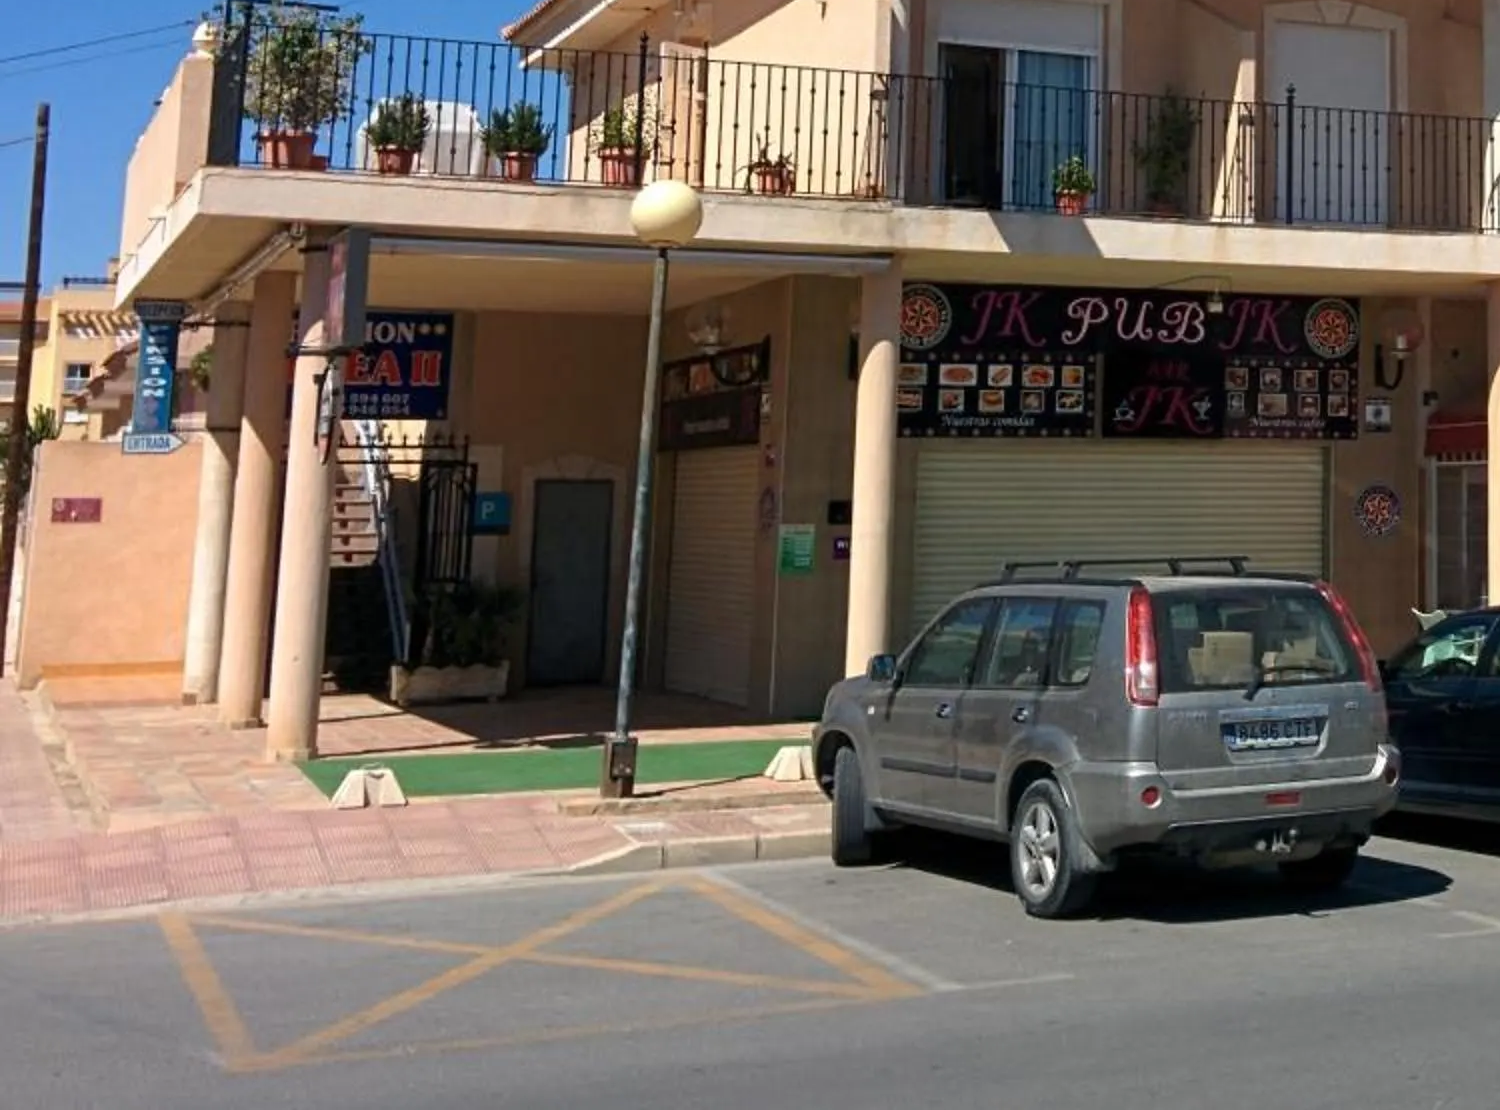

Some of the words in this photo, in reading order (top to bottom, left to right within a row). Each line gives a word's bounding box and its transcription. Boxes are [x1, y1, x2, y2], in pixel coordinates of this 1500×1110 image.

[959, 291, 1048, 348] JK
[1061, 297, 1206, 344] PUB
[1218, 299, 1300, 353] JK
[127, 437, 170, 451] ENTRADA
